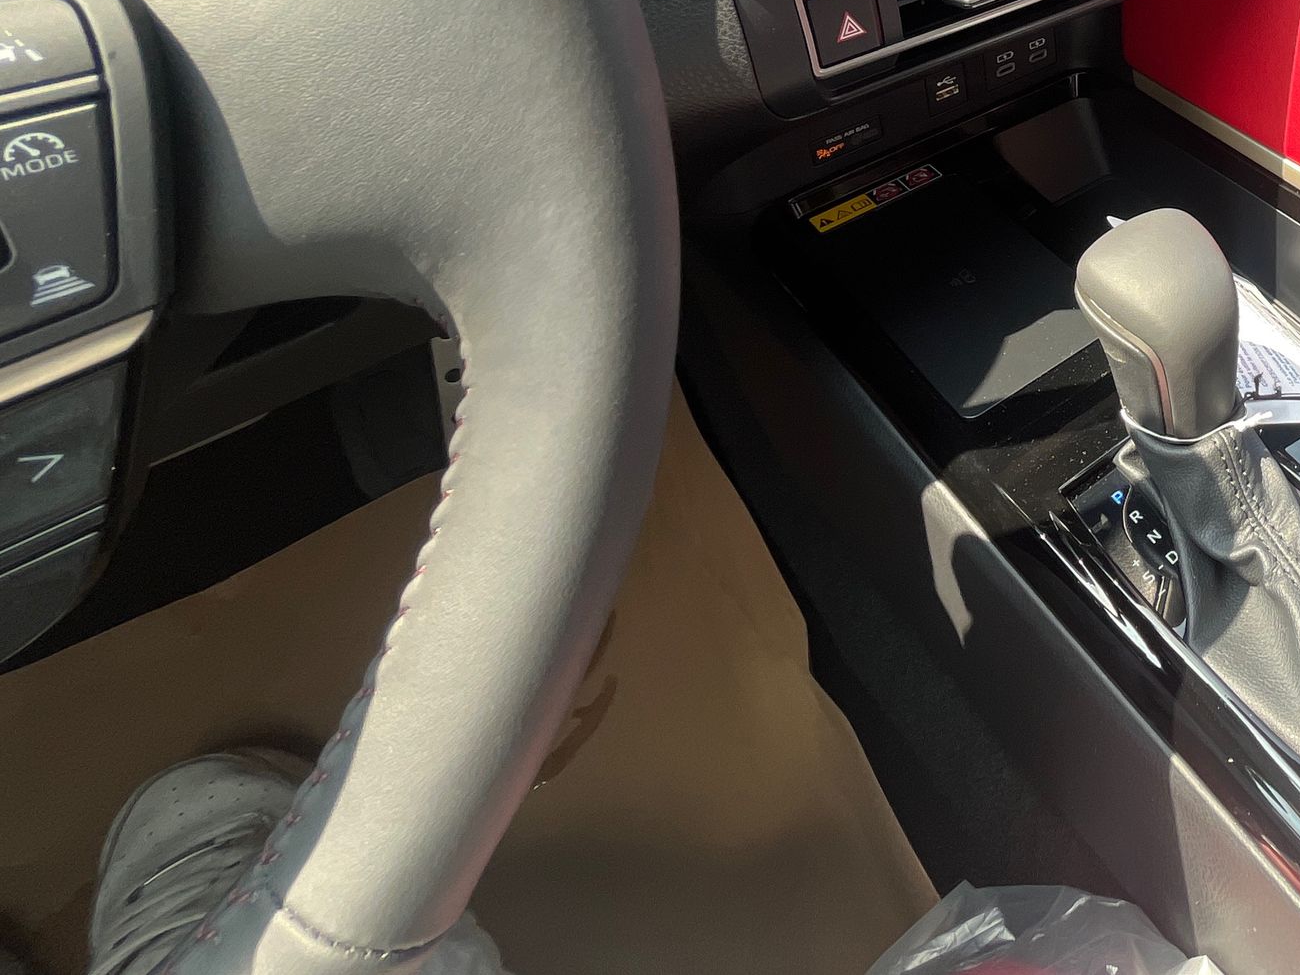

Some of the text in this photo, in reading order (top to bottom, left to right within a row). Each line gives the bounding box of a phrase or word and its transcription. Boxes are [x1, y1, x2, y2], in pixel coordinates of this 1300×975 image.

[825, 123, 870, 145] PASS AIR BAG
[828, 142, 846, 154] OFF
[0, 148, 80, 182] MODE
[1110, 489, 1126, 506] P
[1128, 509, 1144, 525] R
[1146, 528, 1163, 545] N
[1165, 550, 1180, 566] D
[1142, 569, 1156, 585] S
